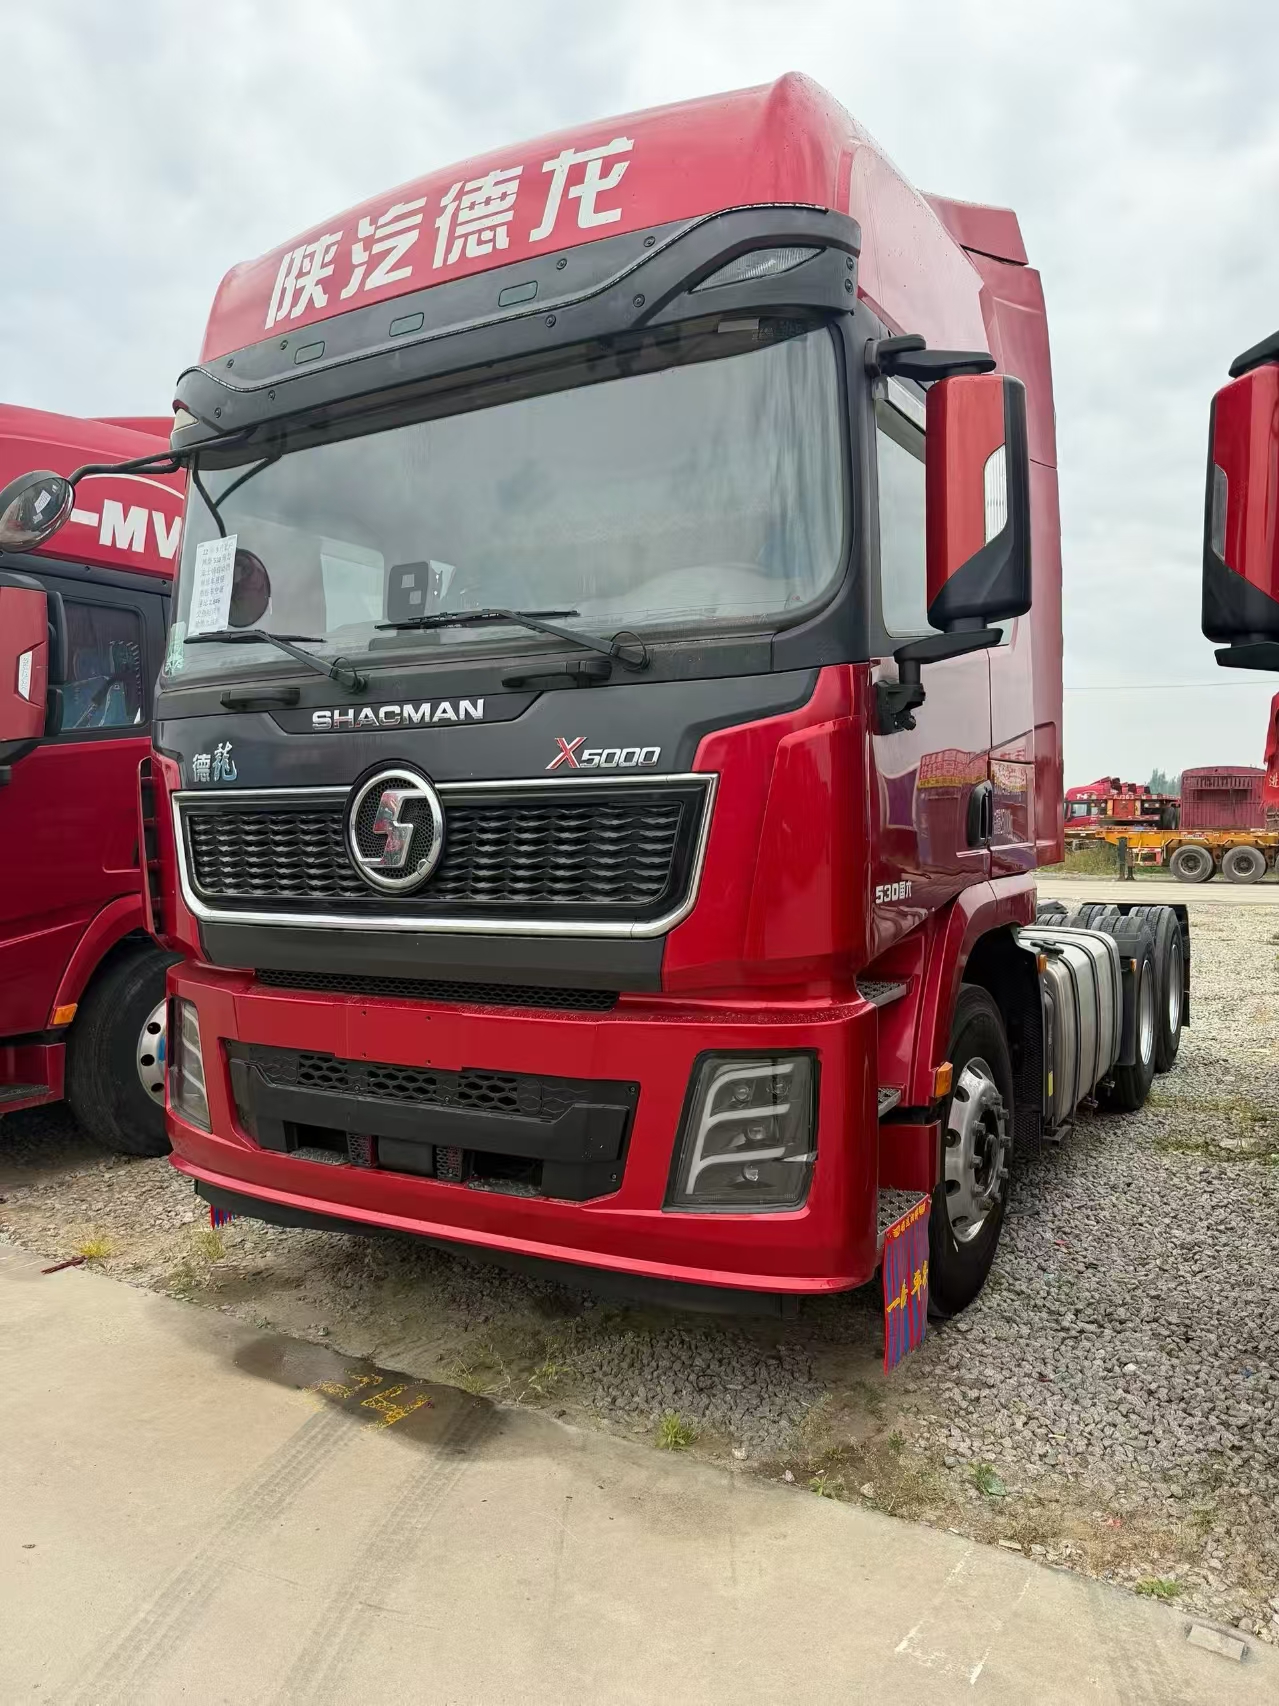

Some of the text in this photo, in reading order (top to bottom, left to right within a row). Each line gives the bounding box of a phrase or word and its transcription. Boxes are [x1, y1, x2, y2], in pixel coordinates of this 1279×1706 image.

[265, 137, 634, 330] 陕汽德龙
[312, 699, 485, 730] SHACMAN
[545, 737, 661, 770] X5000
